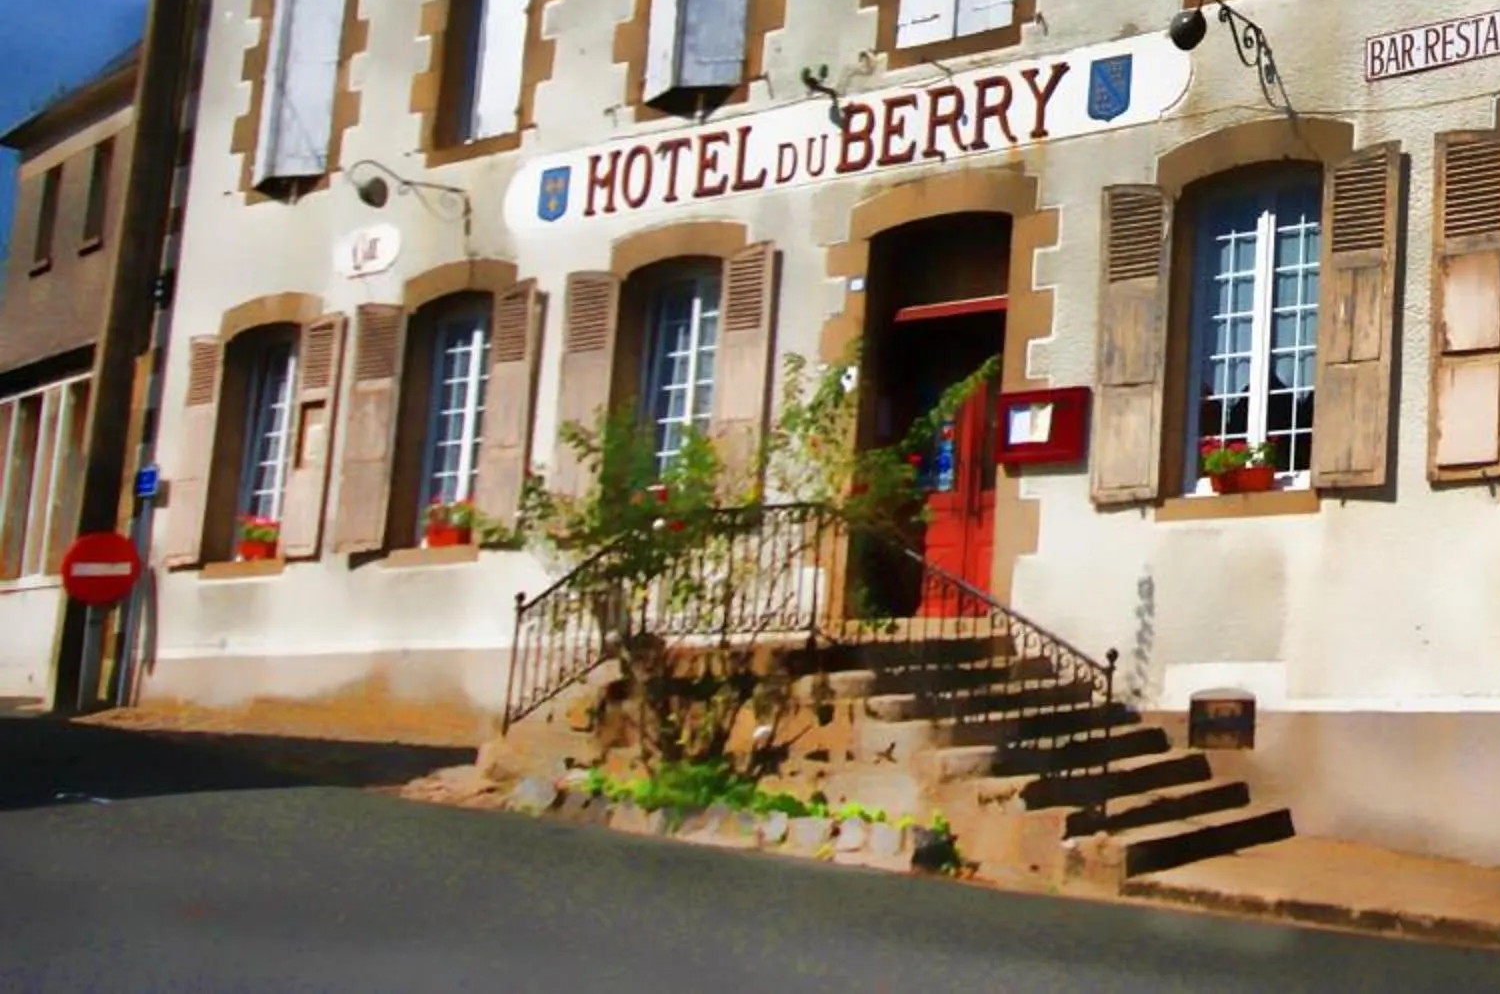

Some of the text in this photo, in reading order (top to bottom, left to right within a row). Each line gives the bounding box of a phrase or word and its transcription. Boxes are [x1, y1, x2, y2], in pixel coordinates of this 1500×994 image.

[583, 61, 1071, 217] HOTEL DU BERRY
